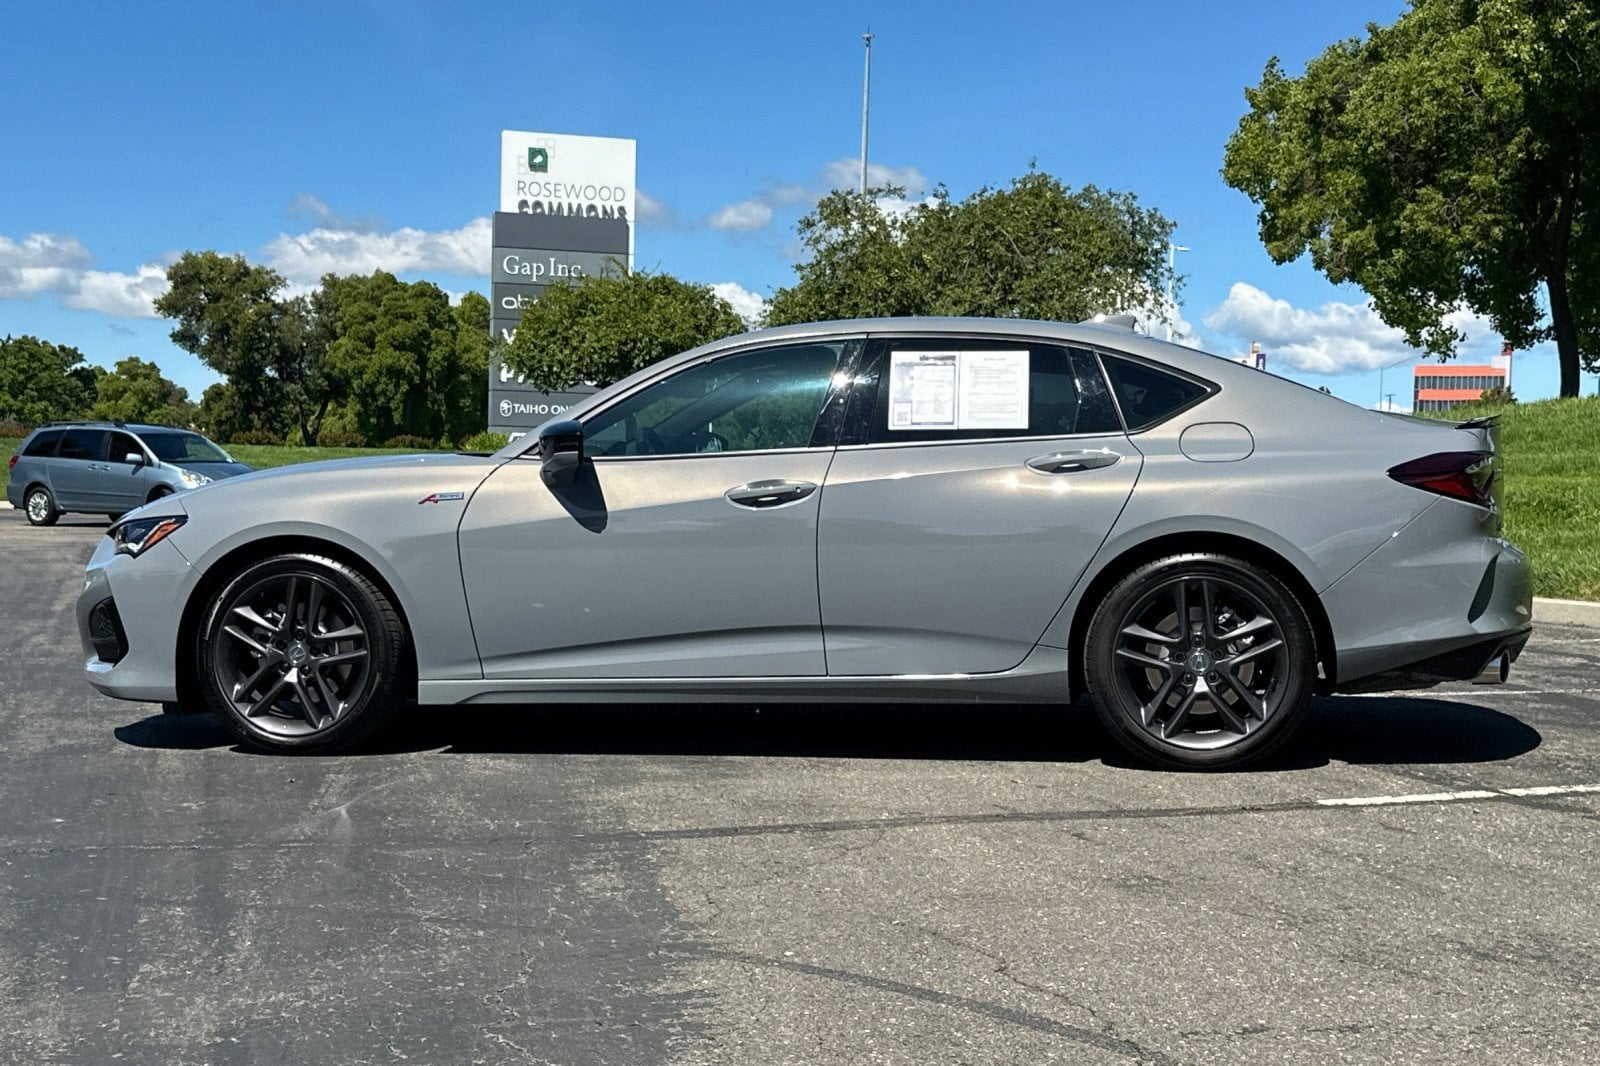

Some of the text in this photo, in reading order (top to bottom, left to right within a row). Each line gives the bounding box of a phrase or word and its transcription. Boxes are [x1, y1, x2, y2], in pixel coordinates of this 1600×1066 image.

[517, 181, 626, 202] ROSEWOOD
[517, 199, 628, 220] COMMONS
[503, 255, 587, 282] Gap Inc.
[513, 403, 549, 415] TAIHO
